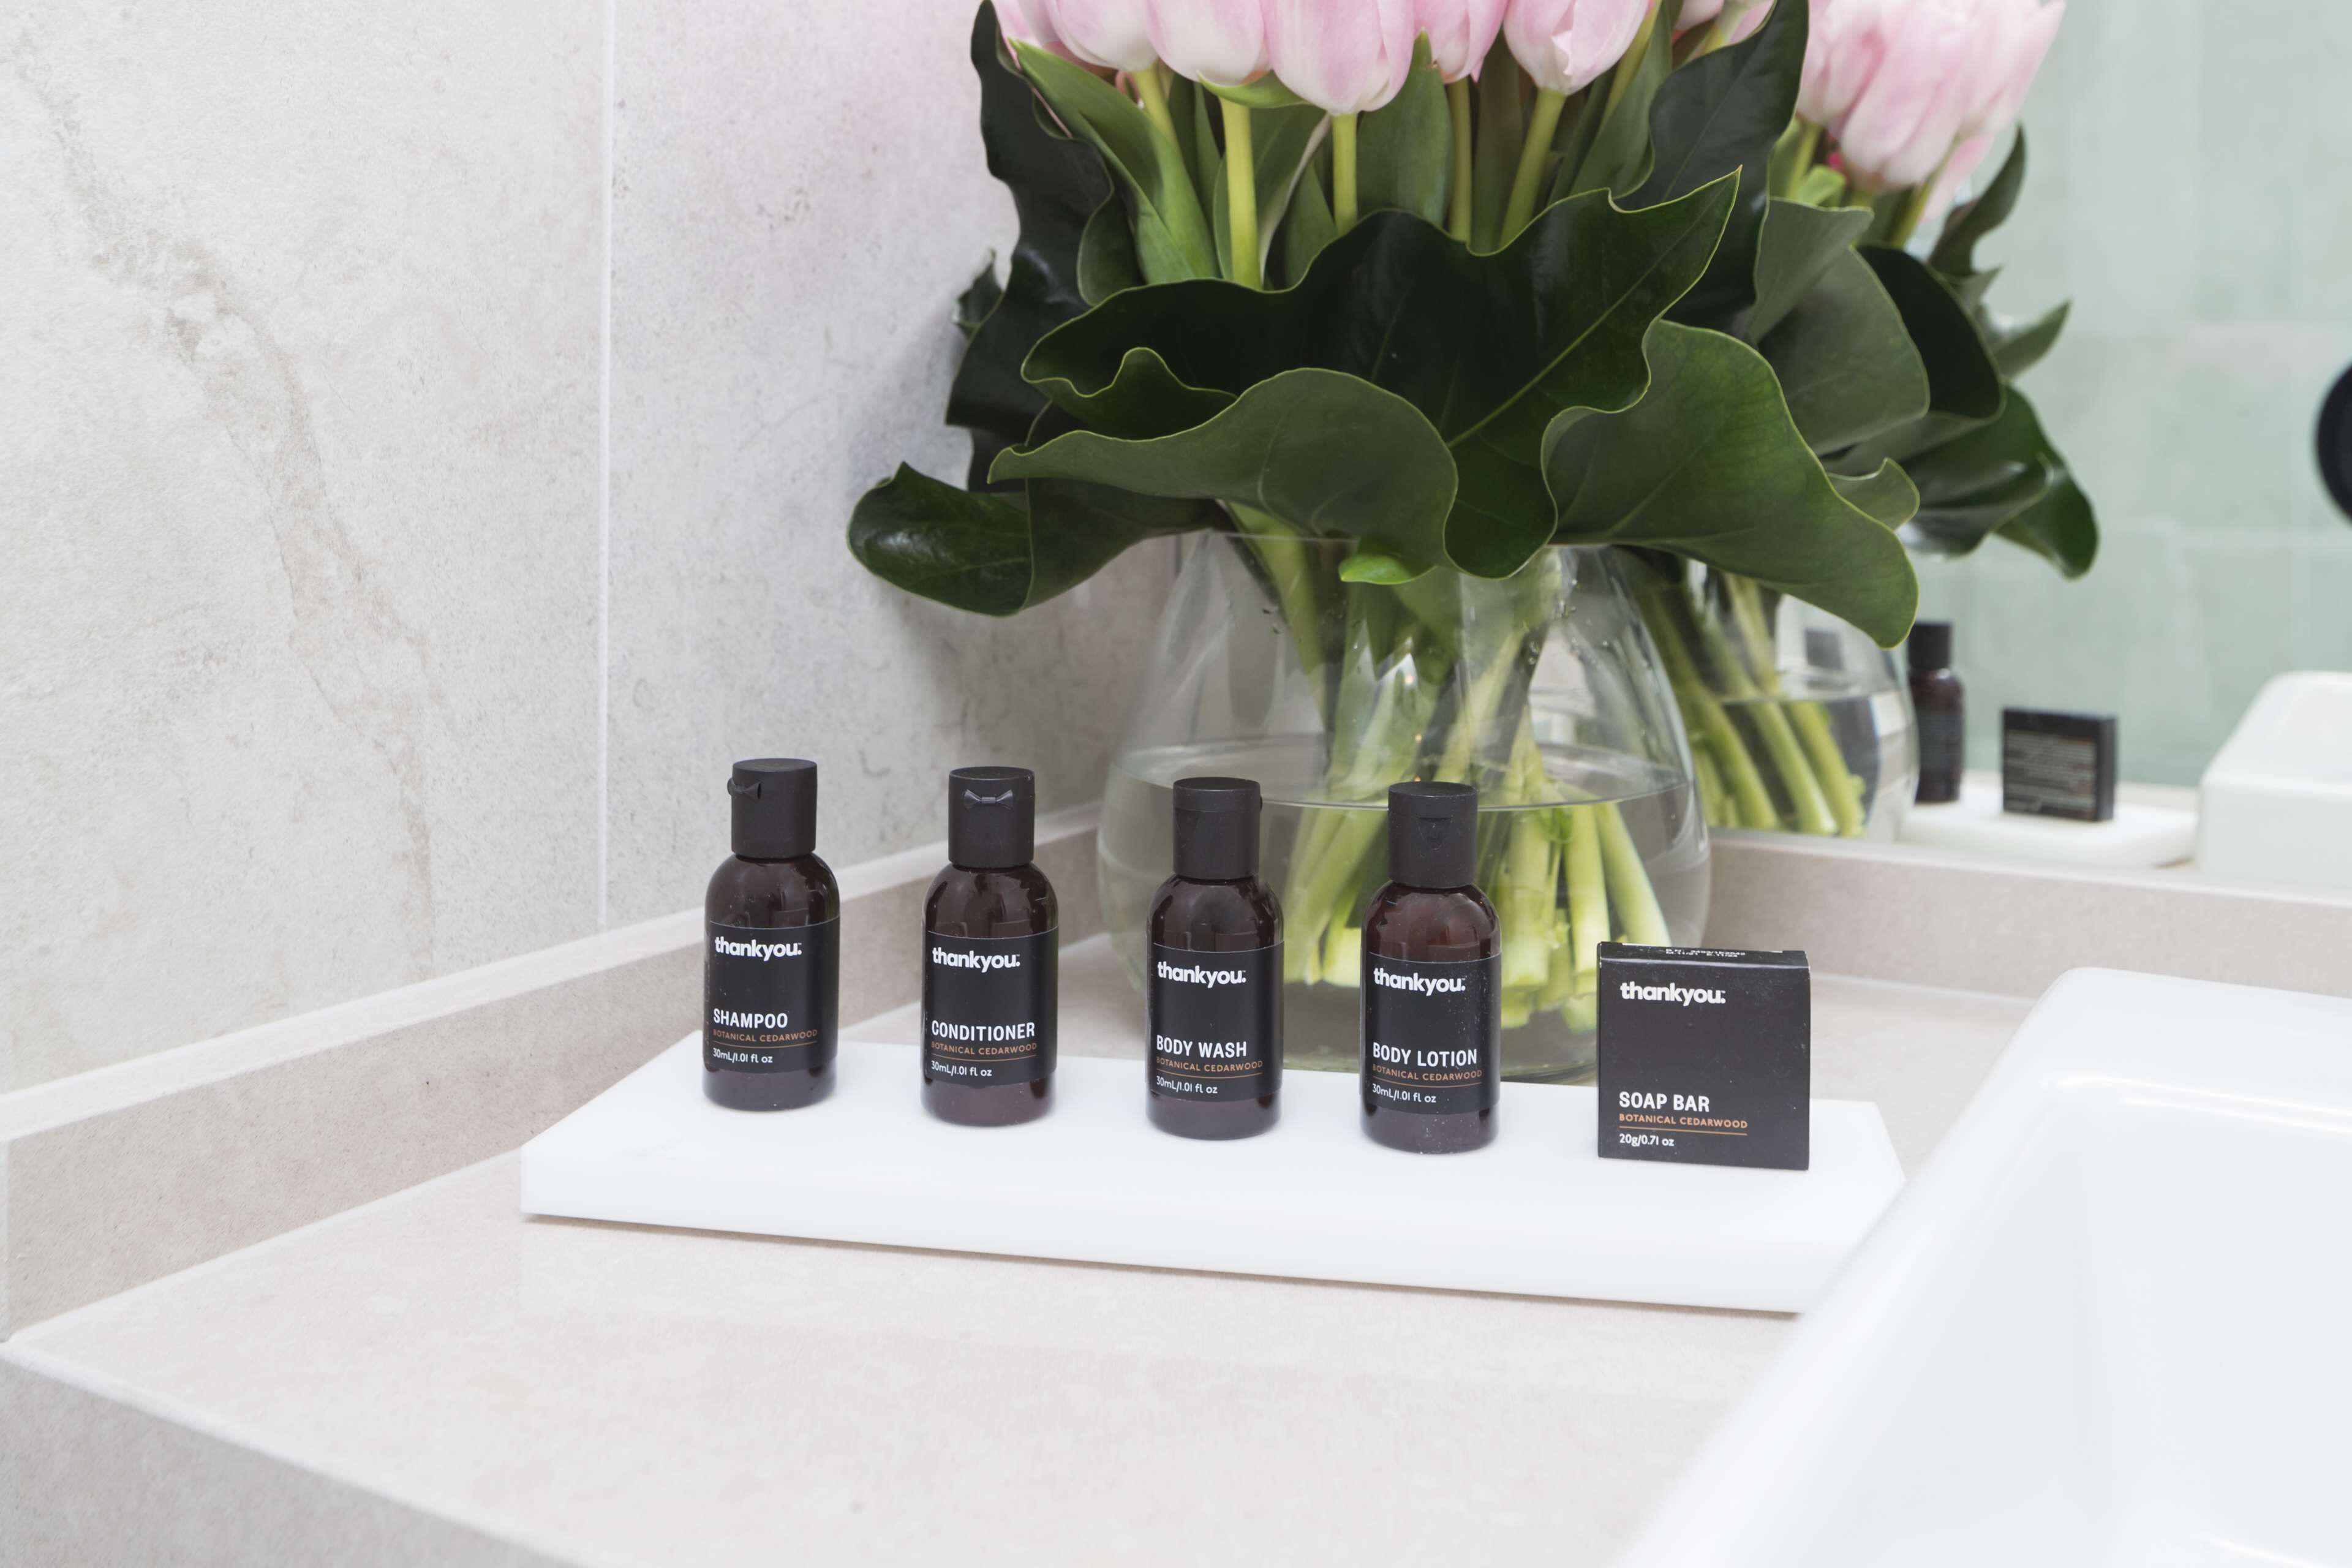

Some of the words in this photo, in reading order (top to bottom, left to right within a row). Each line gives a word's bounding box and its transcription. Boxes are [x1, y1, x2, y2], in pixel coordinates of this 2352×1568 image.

[714, 1008, 788, 1028] SHAMPOO
[713, 1029, 756, 1041] BOTANICAL
[760, 1030, 818, 1042] CEDARWOOD
[932, 1020, 1035, 1041] CONDITIONER
[932, 1041, 975, 1054] BOTANICAL
[978, 1043, 1036, 1055] CEDARWOOD
[1157, 1035, 1193, 1056] BODY
[1199, 1041, 1246, 1058] WASH
[751, 1054, 758, 1063] fl
[1373, 1042, 1411, 1065] BODY
[1417, 1049, 1477, 1066] LOTION
[970, 1067, 978, 1076] fl
[1157, 1057, 1200, 1071] BOTANICAL
[1204, 1060, 1262, 1072] CEDARWOOD
[1373, 1064, 1418, 1079] BOTANICAL
[1422, 1070, 1482, 1080] CEDARWOOD
[1196, 1084, 1203, 1093] fl
[1414, 1093, 1421, 1102] fl
[1619, 1091, 1667, 1109] SOAP
[1673, 1094, 1709, 1112] BAR
[1619, 1114, 1676, 1124] BOTANICAL
[1680, 1117, 1747, 1128] CEDARWOOD
